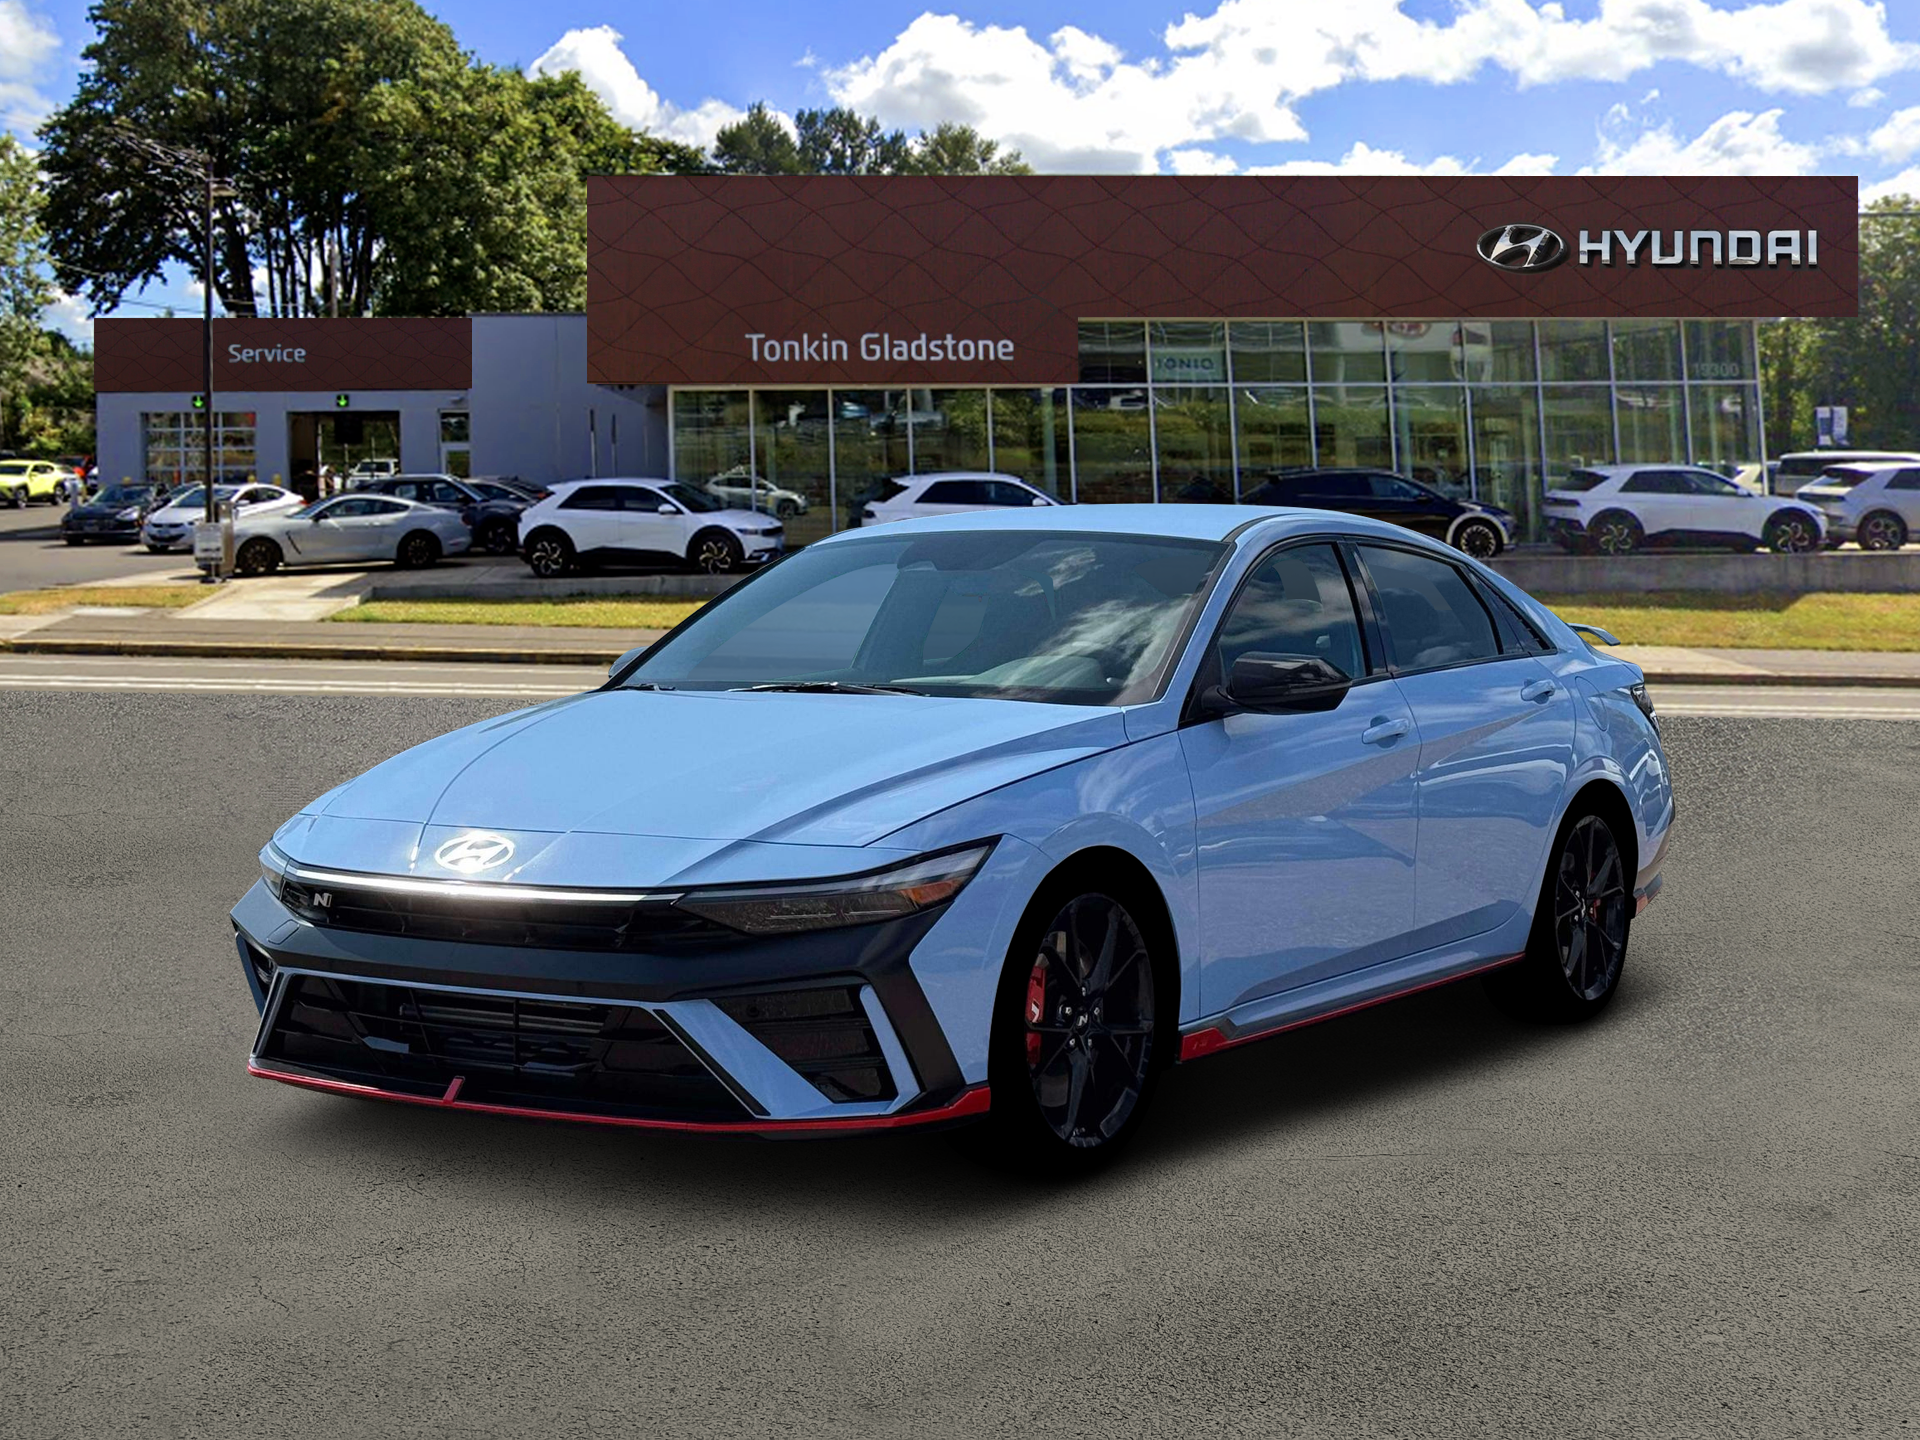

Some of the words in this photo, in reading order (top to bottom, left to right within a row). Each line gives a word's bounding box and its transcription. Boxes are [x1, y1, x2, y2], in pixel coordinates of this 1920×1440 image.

[1579, 230, 1817, 264] HYUNDAI
[227, 343, 307, 363] Service
[745, 333, 848, 362] Tonkin
[860, 332, 1014, 362] Gladstone
[1157, 357, 1214, 371] IONIQ
